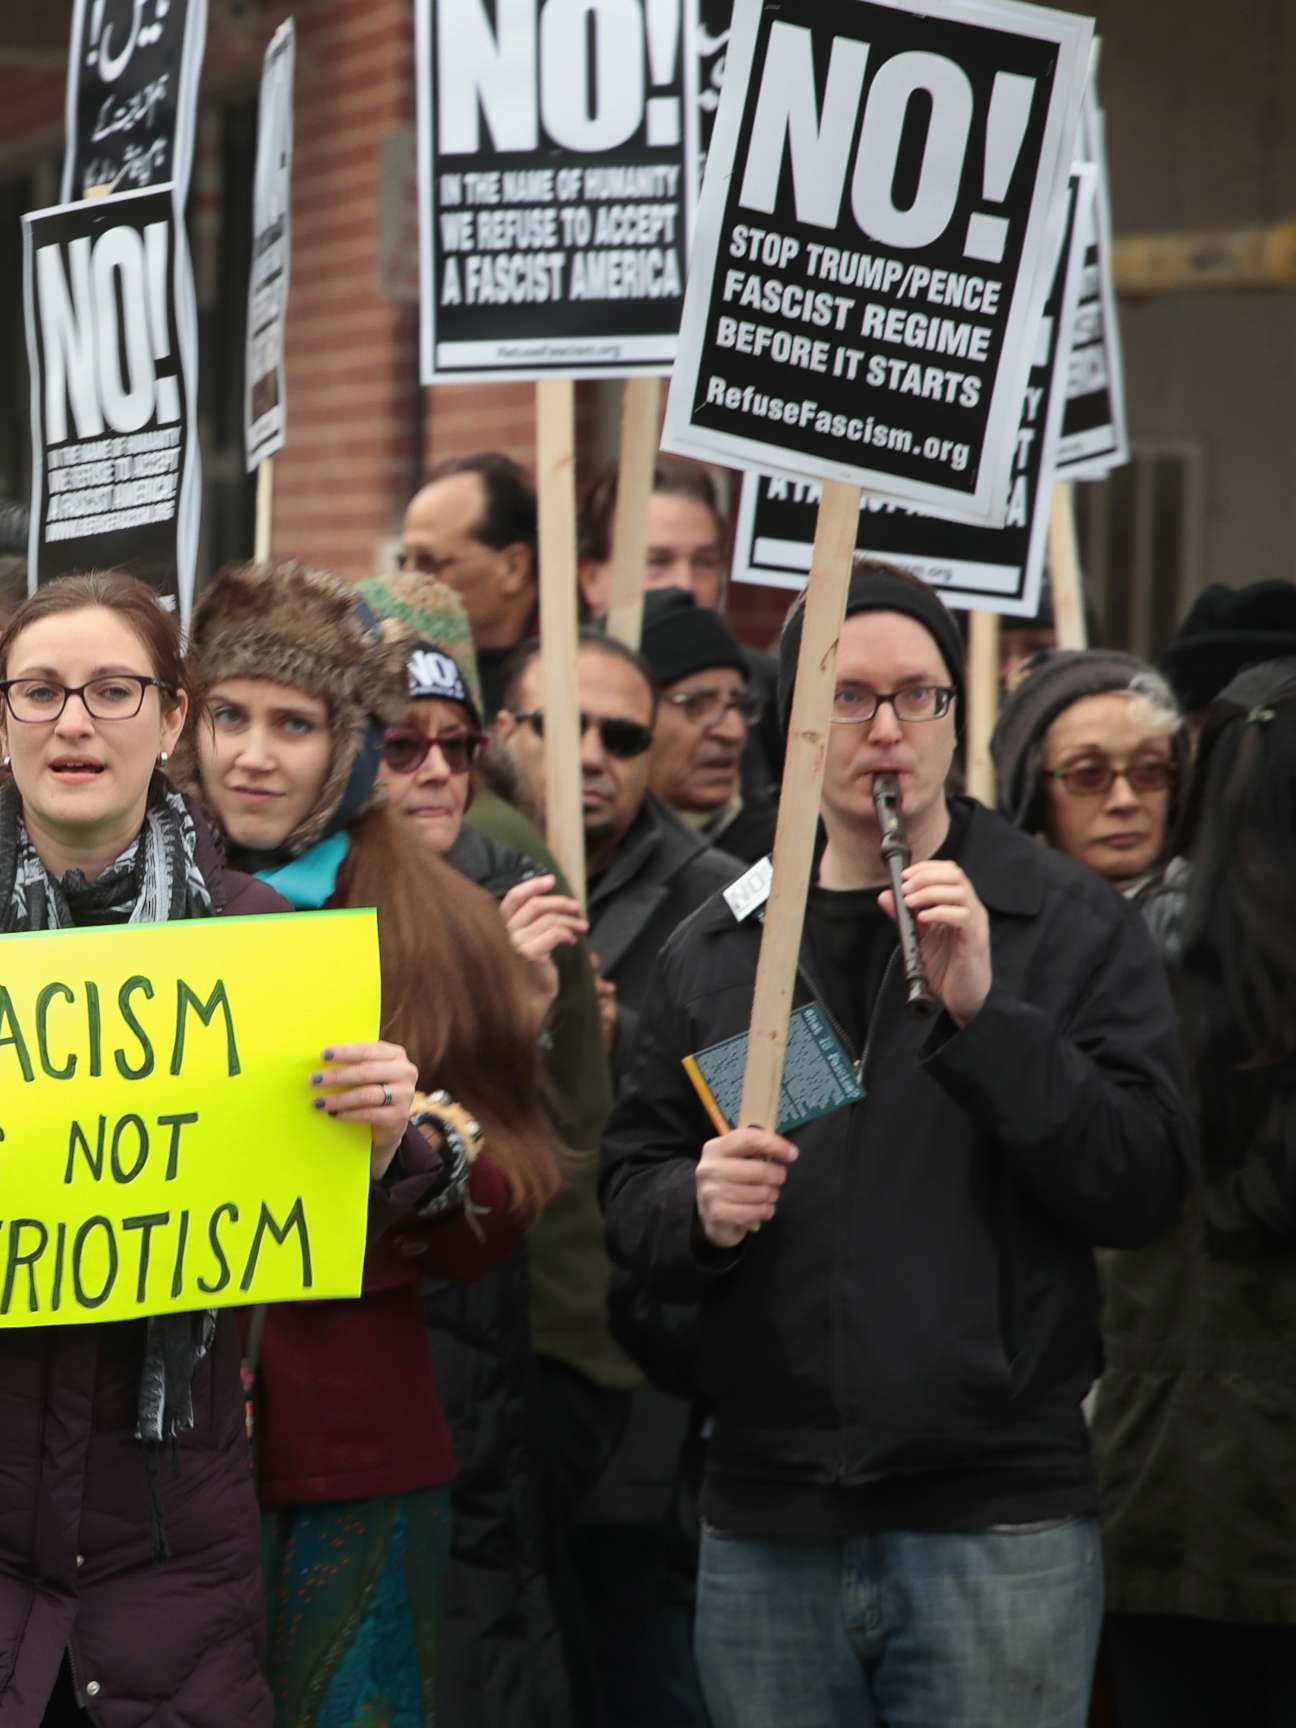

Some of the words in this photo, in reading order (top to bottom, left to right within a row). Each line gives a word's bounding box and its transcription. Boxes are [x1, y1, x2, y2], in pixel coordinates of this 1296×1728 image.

[439, 0, 682, 155] NO!
[439, 173, 462, 206] IN
[464, 171, 501, 205] THE
[502, 169, 554, 204] NAME
[556, 167, 584, 201] OF
[583, 164, 681, 200] HUMANITY
[739, 20, 1037, 264] NO!
[439, 211, 475, 252] WE
[476, 207, 558, 251] REFUSE
[560, 205, 592, 248] TO
[593, 203, 678, 246] ACCEPT
[729, 224, 800, 269] STOP
[805, 242, 1002, 315] TRUMP/PENCE
[441, 256, 462, 306] A
[465, 251, 566, 306] FASCIST
[569, 248, 682, 301] AMERICA
[722, 269, 856, 331] FASCIST
[860, 303, 993, 362] REGIME
[37, 220, 180, 447] NO!
[716, 315, 831, 374] BEFORE
[832, 346, 865, 381] IT
[866, 354, 983, 409] STARTS
[706, 375, 971, 472] RefuseFascism.org
[64, 1112, 198, 1184] NOT
